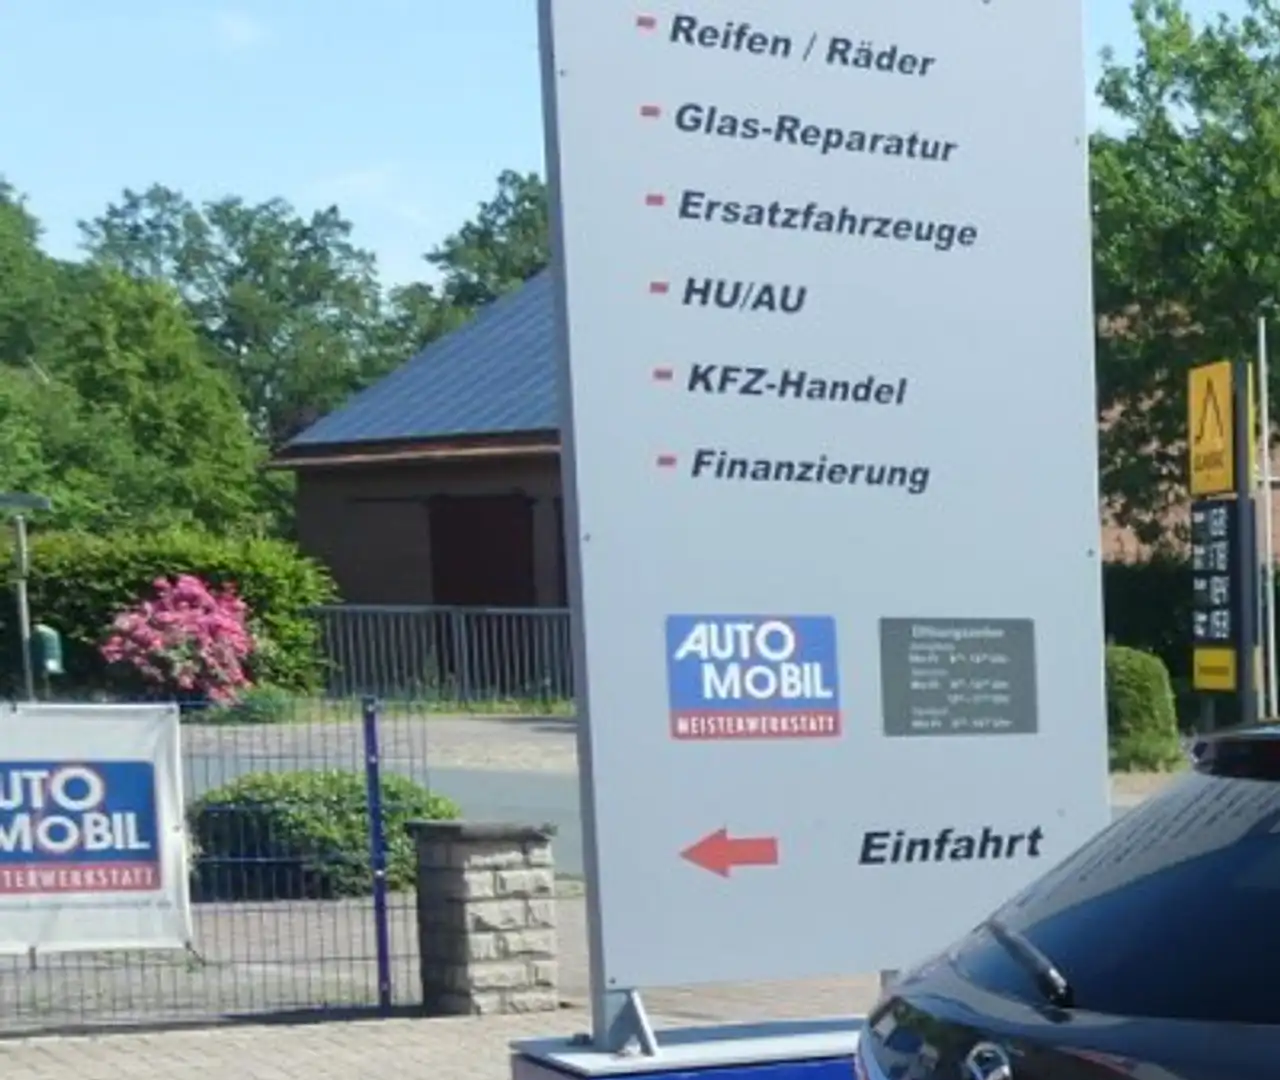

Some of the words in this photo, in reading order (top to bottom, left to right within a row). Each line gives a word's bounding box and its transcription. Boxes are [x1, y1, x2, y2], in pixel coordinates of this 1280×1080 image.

[670, 15, 792, 58] Reifen
[803, 33, 816, 61] /
[826, 37, 936, 77] Räder
[674, 103, 957, 162] Glas-Reparatur
[678, 191, 979, 251] Ersatzfahrzeuge
[682, 278, 807, 314] HU/AU
[687, 365, 908, 405] KFZ-Handel
[692, 450, 931, 494] Finanzierung
[674, 620, 796, 661] AUTO
[703, 662, 833, 699] MOBIL
[677, 716, 834, 735] MEISTERWERKSTATT
[0, 812, 151, 853] MOBIL
[859, 826, 1043, 865] Einfahrt
